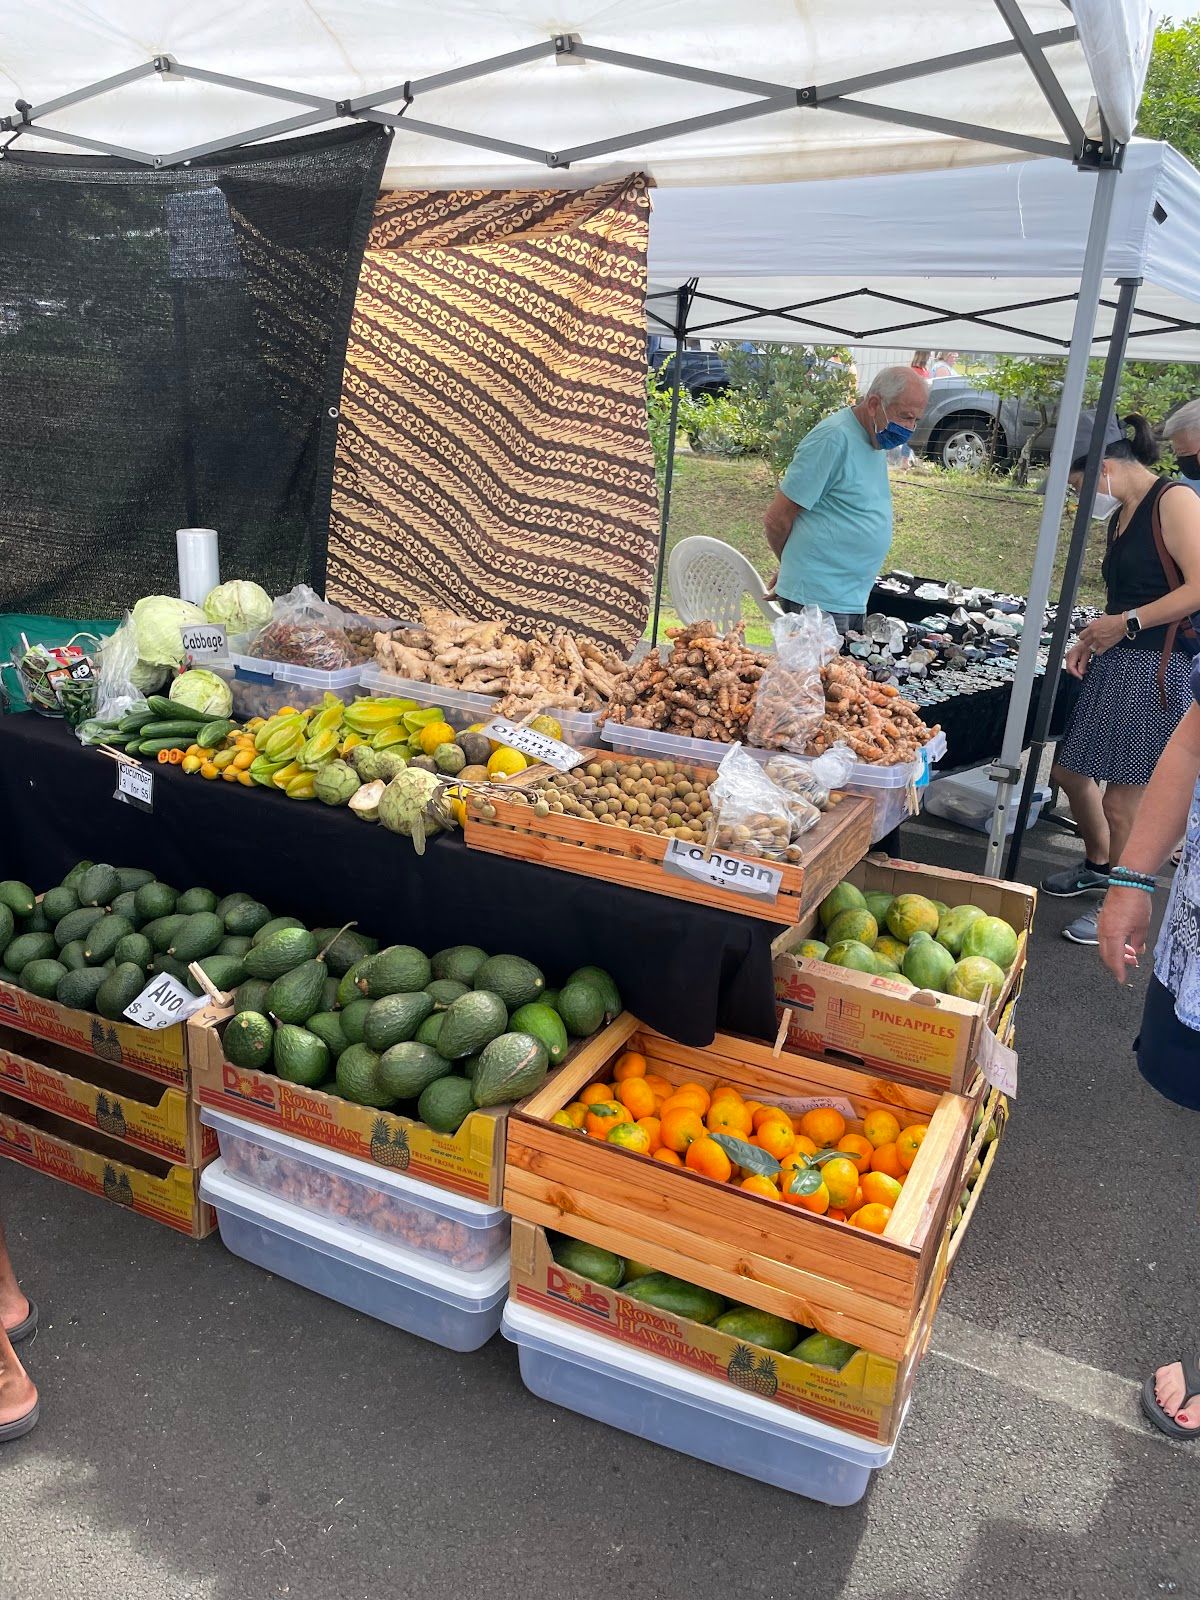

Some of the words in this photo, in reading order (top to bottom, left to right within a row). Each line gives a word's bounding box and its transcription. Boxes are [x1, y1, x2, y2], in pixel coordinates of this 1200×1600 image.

[182, 632, 223, 652] Cabbage
[120, 763, 151, 785] Cucumber
[672, 838, 775, 884] Longan
[871, 1008, 956, 1040] PINEAPPLES
[278, 1084, 332, 1119] ROYAL
[615, 1297, 683, 1338] ROYAL
[616, 1315, 719, 1366] HAWAIIAN
